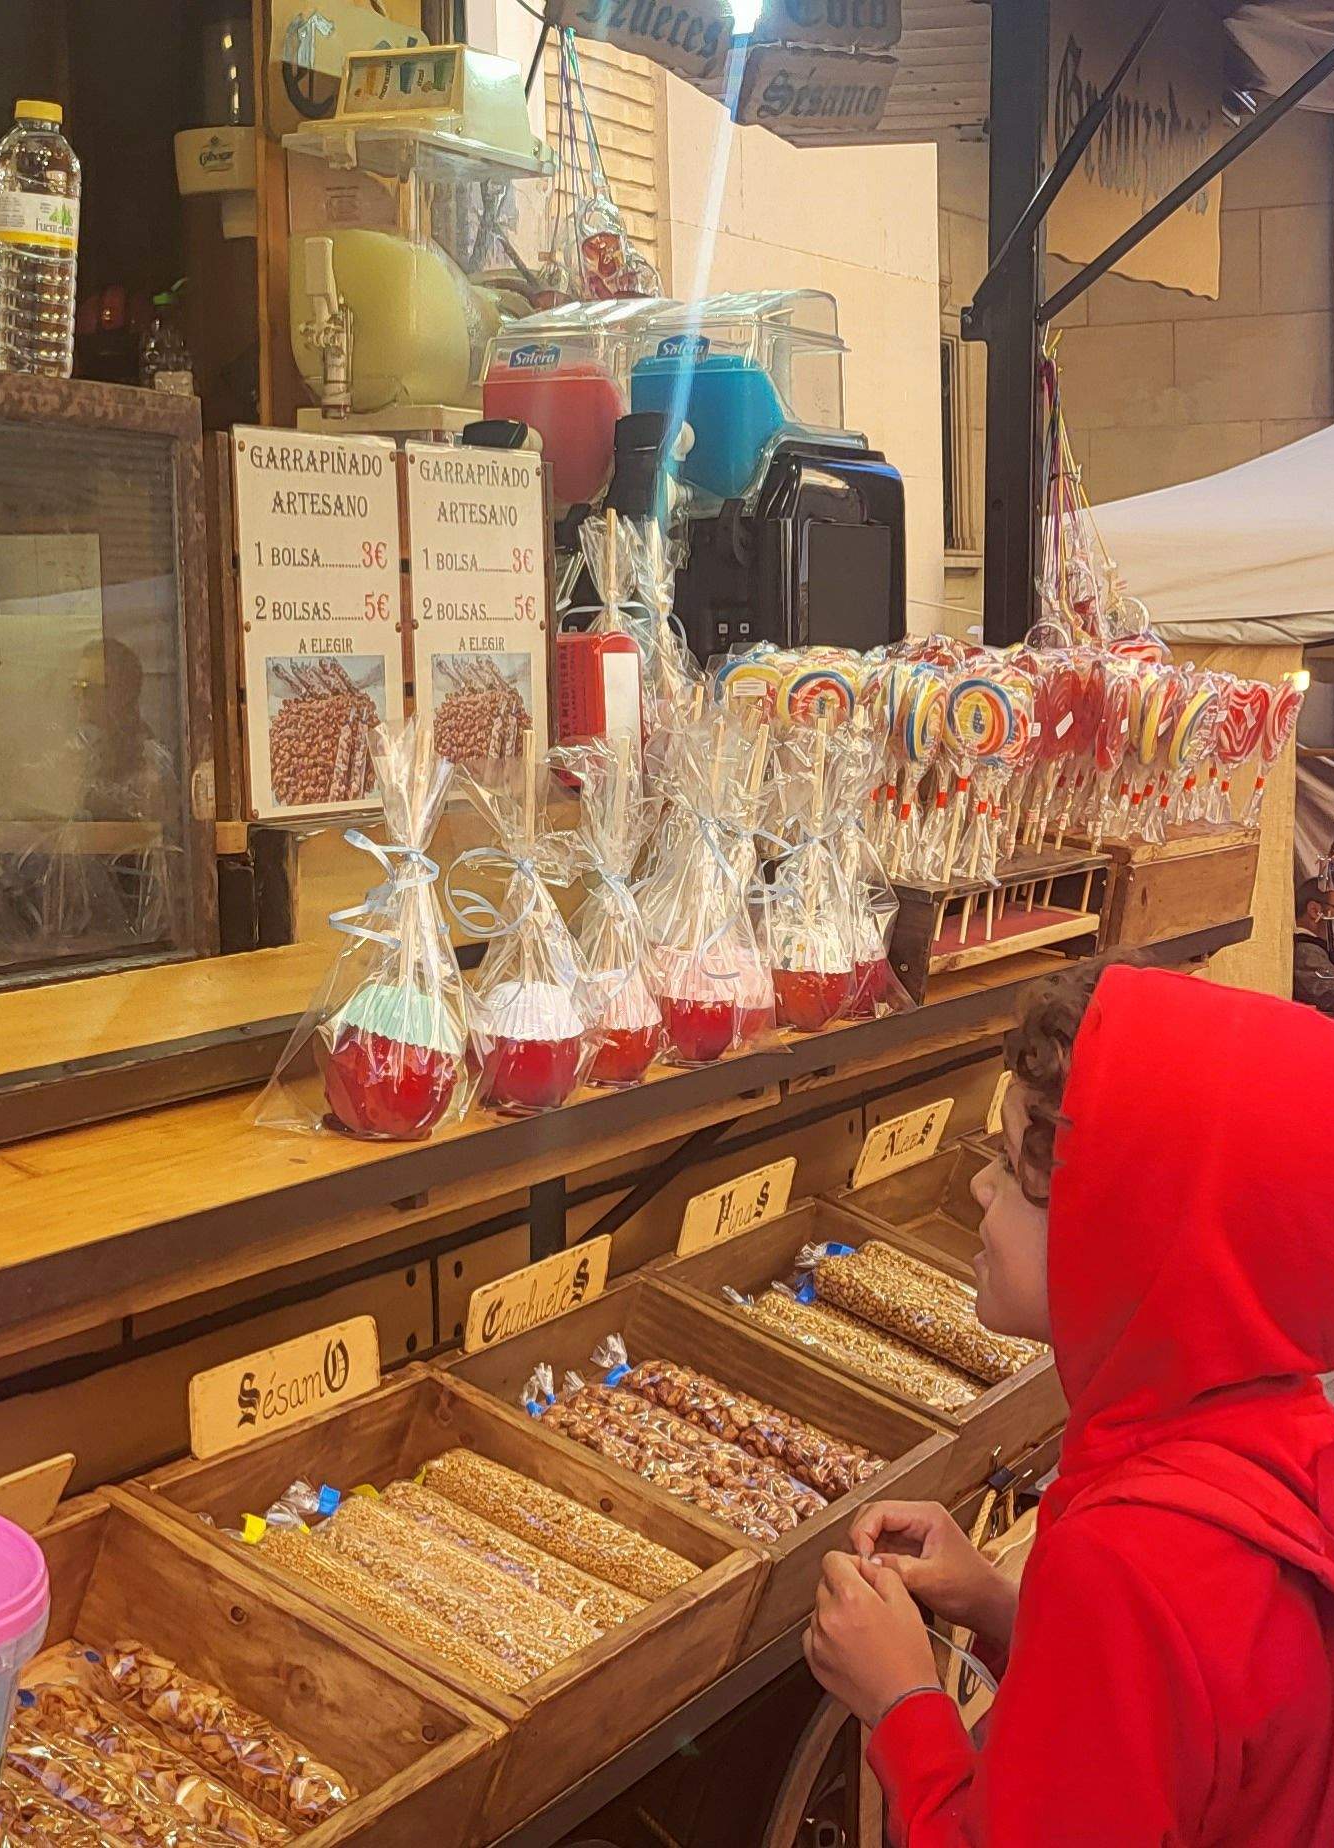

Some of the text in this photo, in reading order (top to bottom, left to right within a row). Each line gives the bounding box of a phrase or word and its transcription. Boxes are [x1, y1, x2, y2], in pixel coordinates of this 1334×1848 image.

[250, 445, 382, 477] GARRAPIÑADO
[419, 459, 530, 489] GARRAPIÑADO
[271, 490, 368, 518] ARTESANO
[437, 501, 518, 527] ARTESANO
[255, 595, 267, 620] 2
[422, 597, 433, 620] 2
[298, 638, 353, 654] A ELEGIR
[458, 637, 505, 652] A ELEGIR
